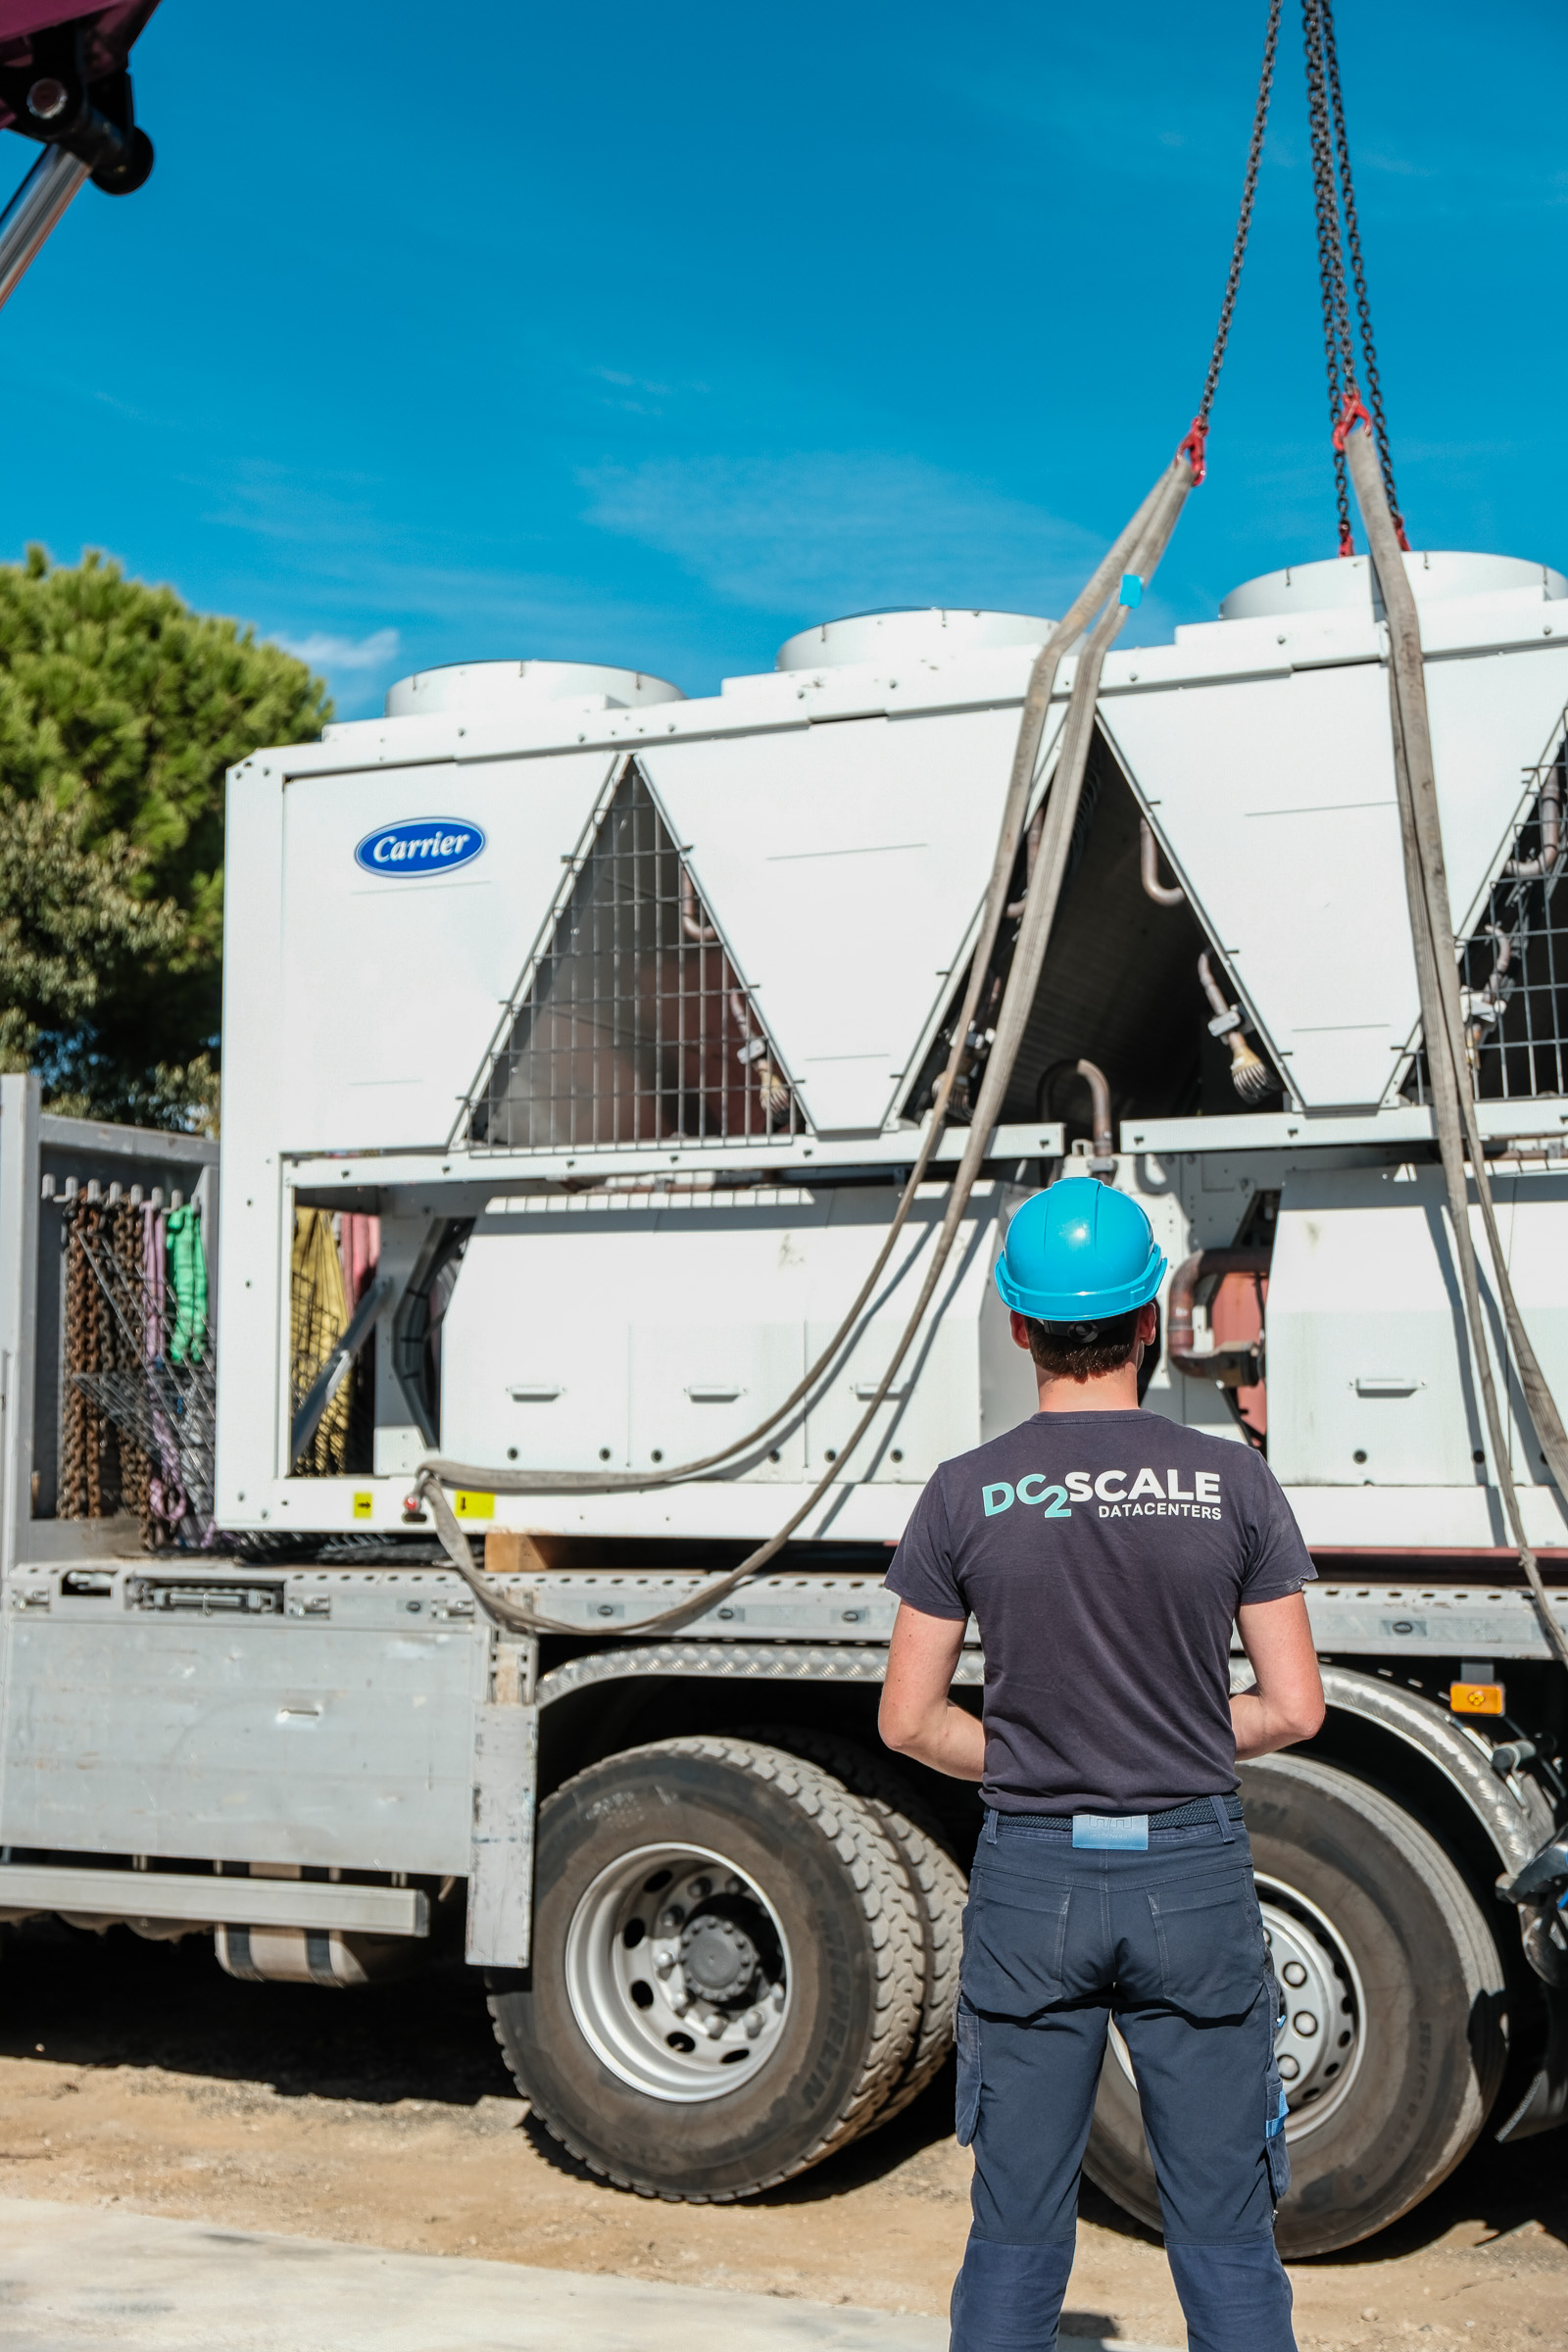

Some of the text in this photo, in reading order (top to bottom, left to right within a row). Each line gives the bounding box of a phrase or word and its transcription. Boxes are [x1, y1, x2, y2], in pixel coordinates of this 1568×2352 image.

[373, 830, 470, 863] Carrier
[1099, 1501, 1222, 1520] DATACENTERS
[801, 1909, 852, 2110] MICHELIN
